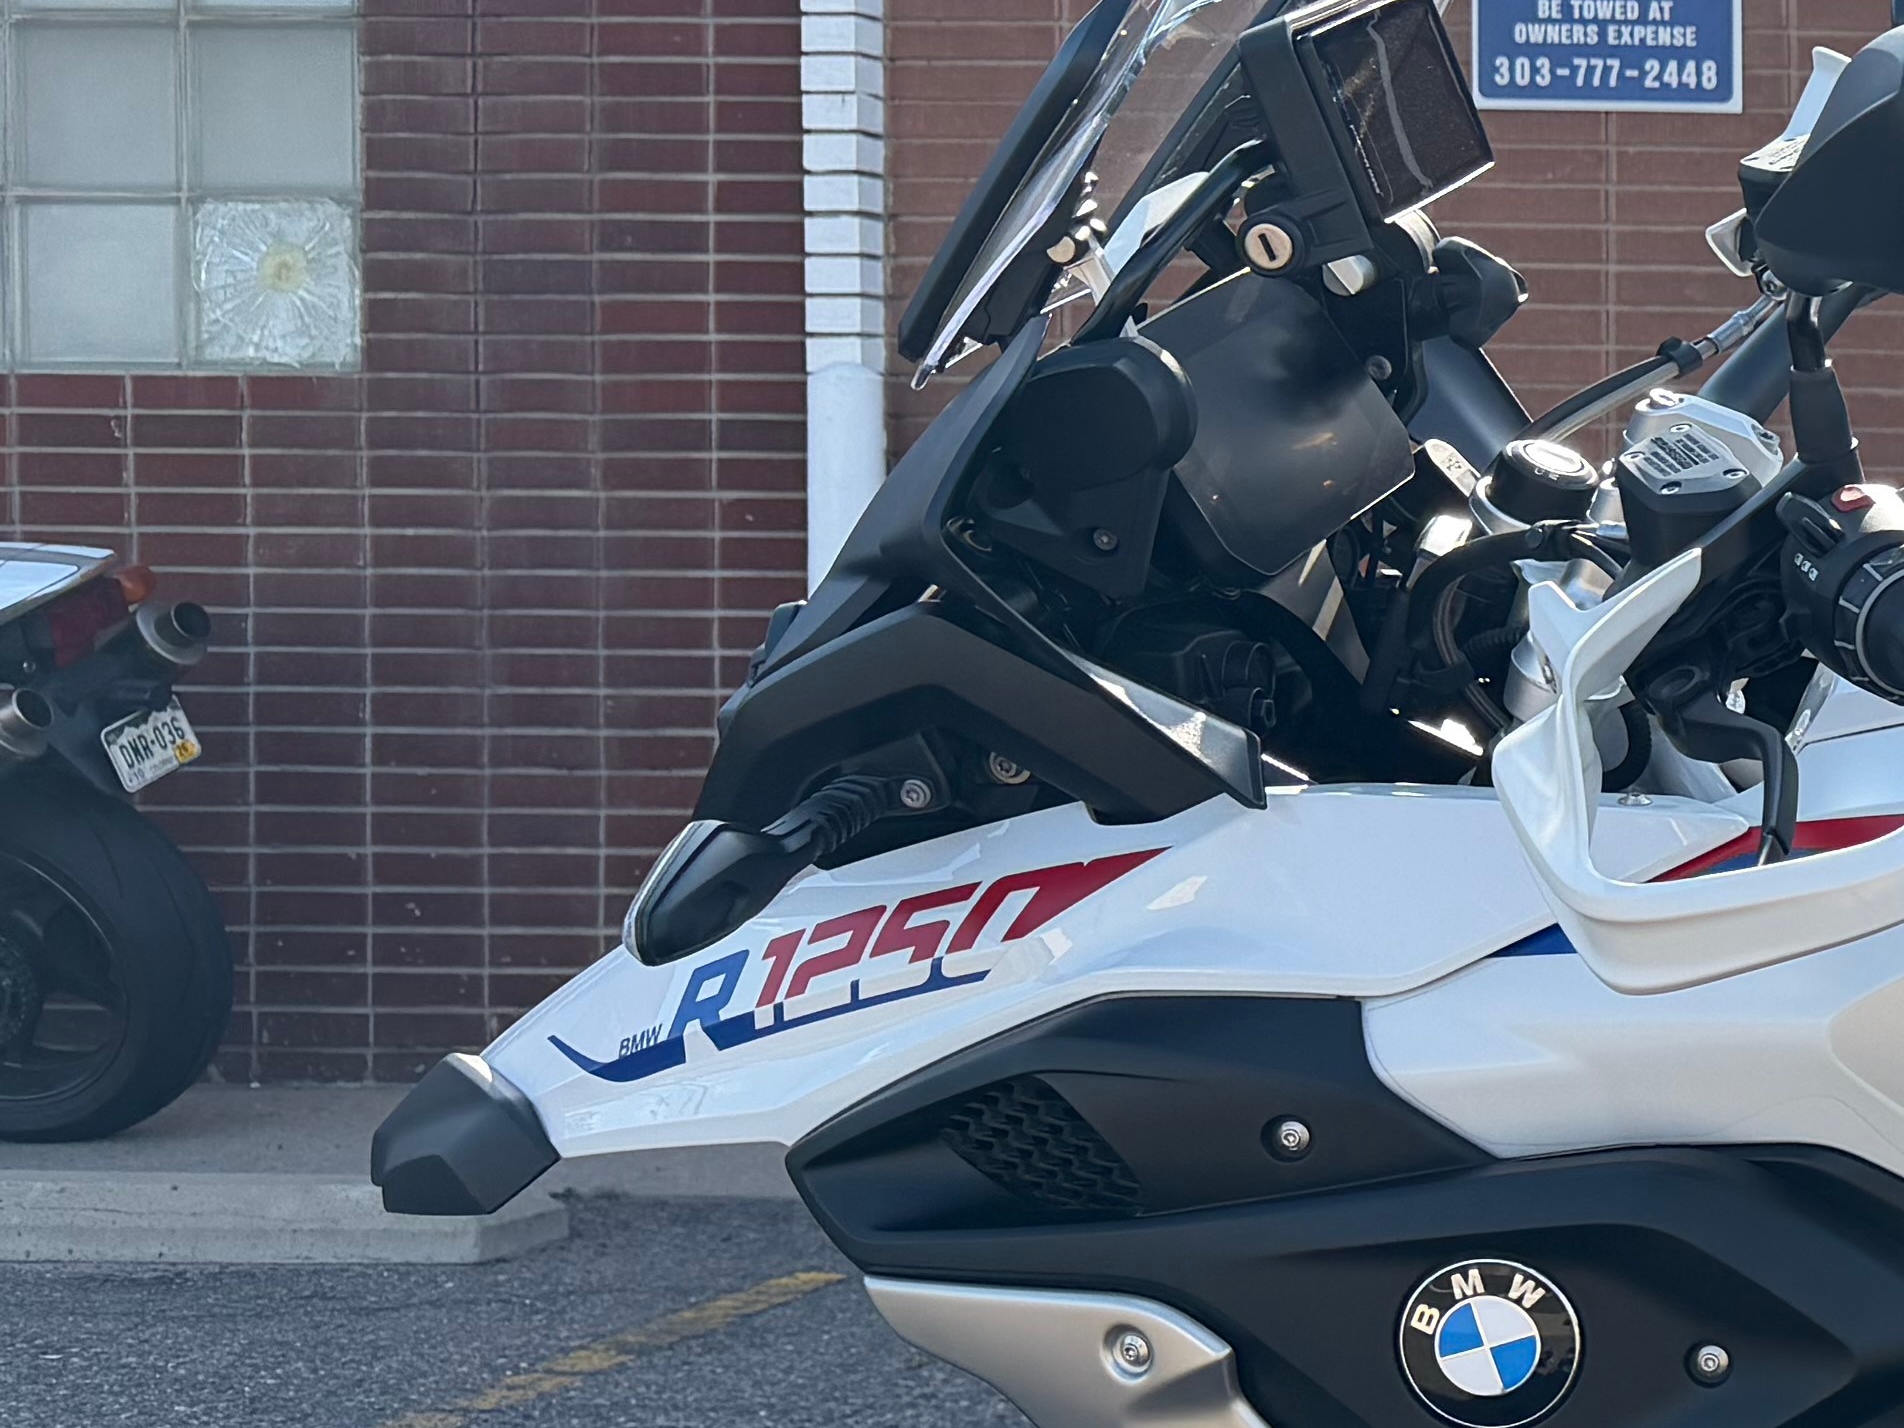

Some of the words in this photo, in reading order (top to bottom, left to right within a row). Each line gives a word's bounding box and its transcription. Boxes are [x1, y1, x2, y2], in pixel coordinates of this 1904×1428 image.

[1571, 0, 1640, 21] TOWED
[1648, 0, 1674, 21] AT
[1514, 22, 1599, 45] OWNERS
[1608, 24, 1698, 47] EXPENSE
[1494, 56, 1718, 90] 303-777-2448
[618, 1023, 663, 1060] BMW
[1410, 1268, 1546, 1335] BMW
